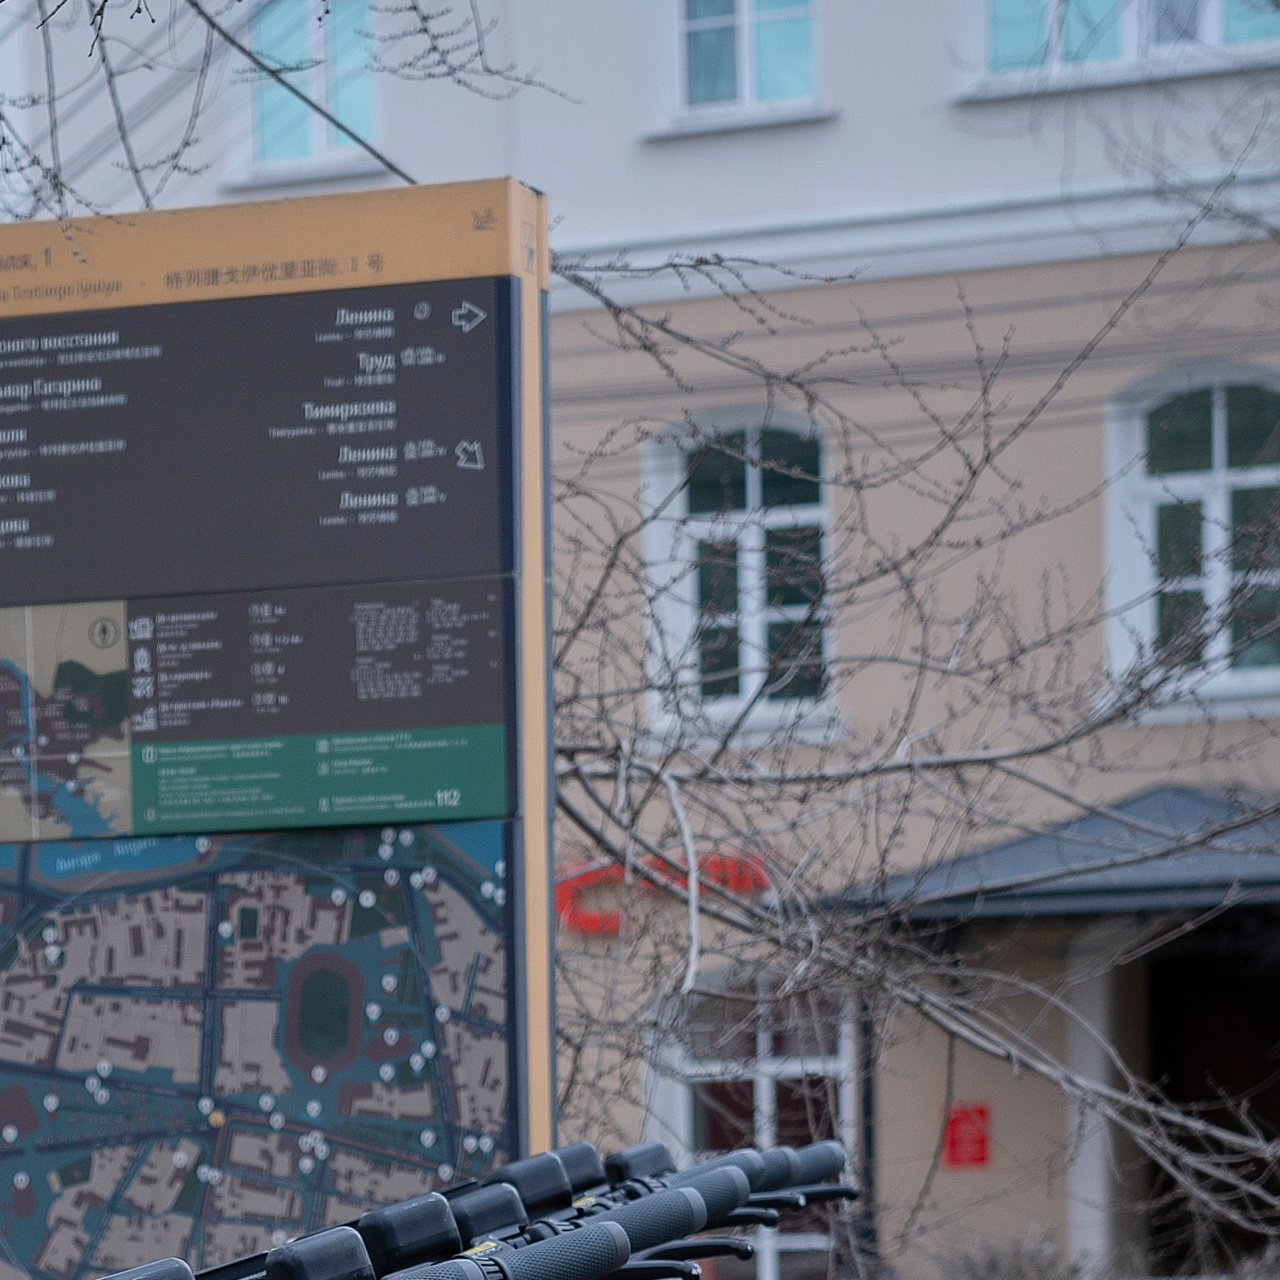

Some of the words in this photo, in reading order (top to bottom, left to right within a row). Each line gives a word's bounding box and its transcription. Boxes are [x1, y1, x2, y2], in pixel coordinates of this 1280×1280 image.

[335, 308, 395, 326] Ленина
[338, 445, 398, 464] Ленина
[339, 491, 399, 510] Ленина
